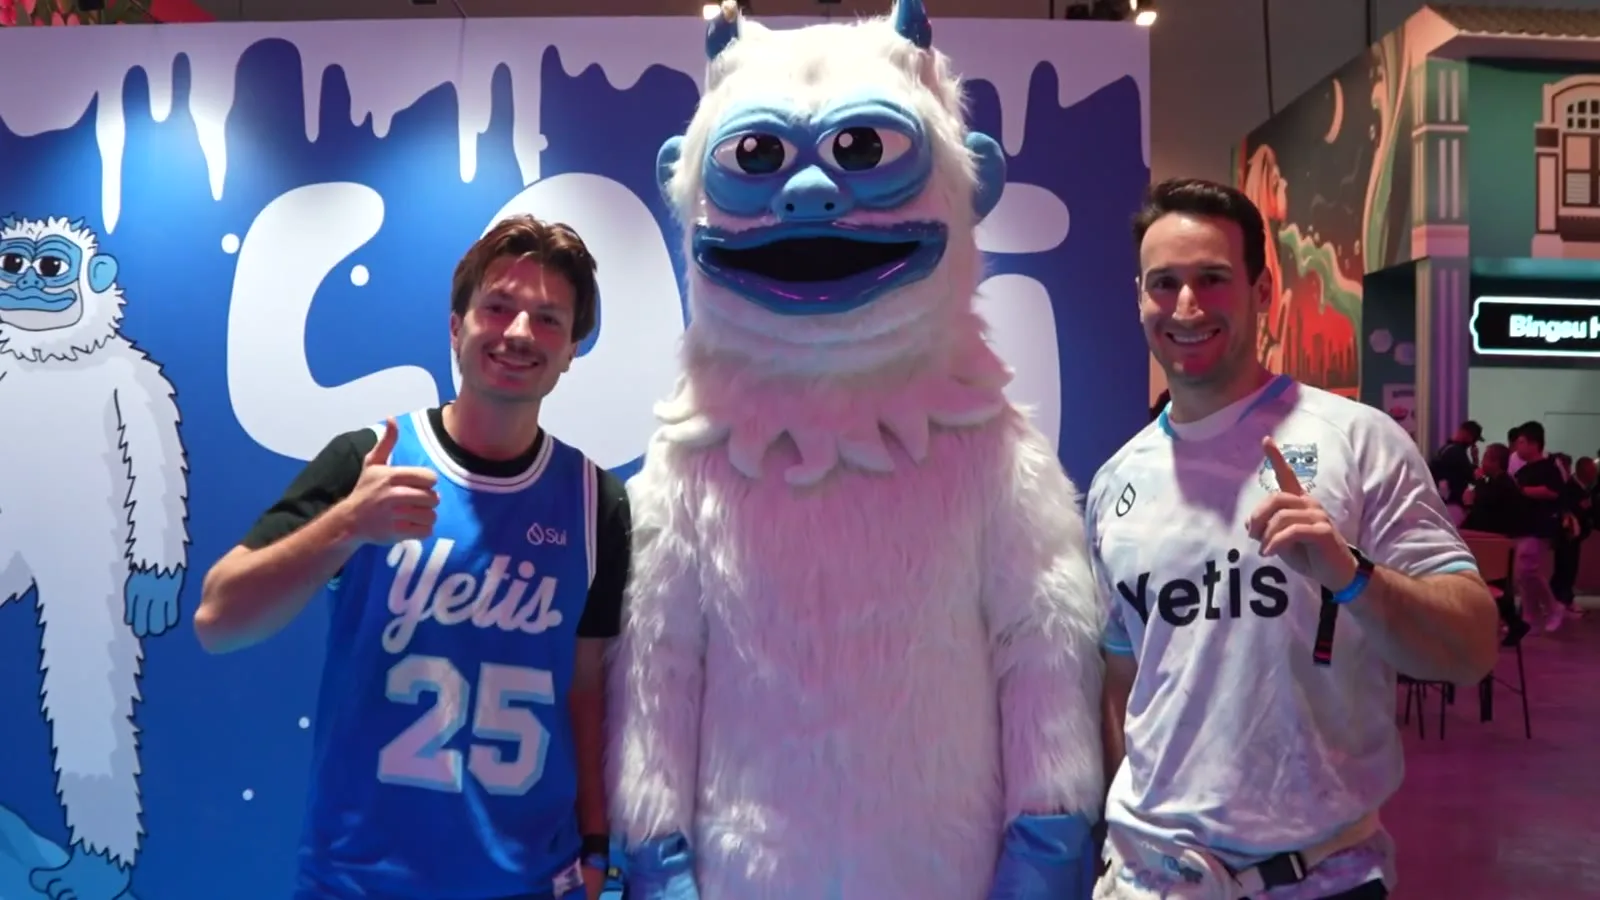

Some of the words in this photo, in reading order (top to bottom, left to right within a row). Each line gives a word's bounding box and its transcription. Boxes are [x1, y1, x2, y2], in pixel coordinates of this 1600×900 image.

[1509, 314, 1588, 343] Bingsu
[545, 528, 567, 546] Sui
[382, 537, 563, 654] Yetis
[1117, 548, 1289, 627] Yetis
[377, 653, 555, 796] 25
